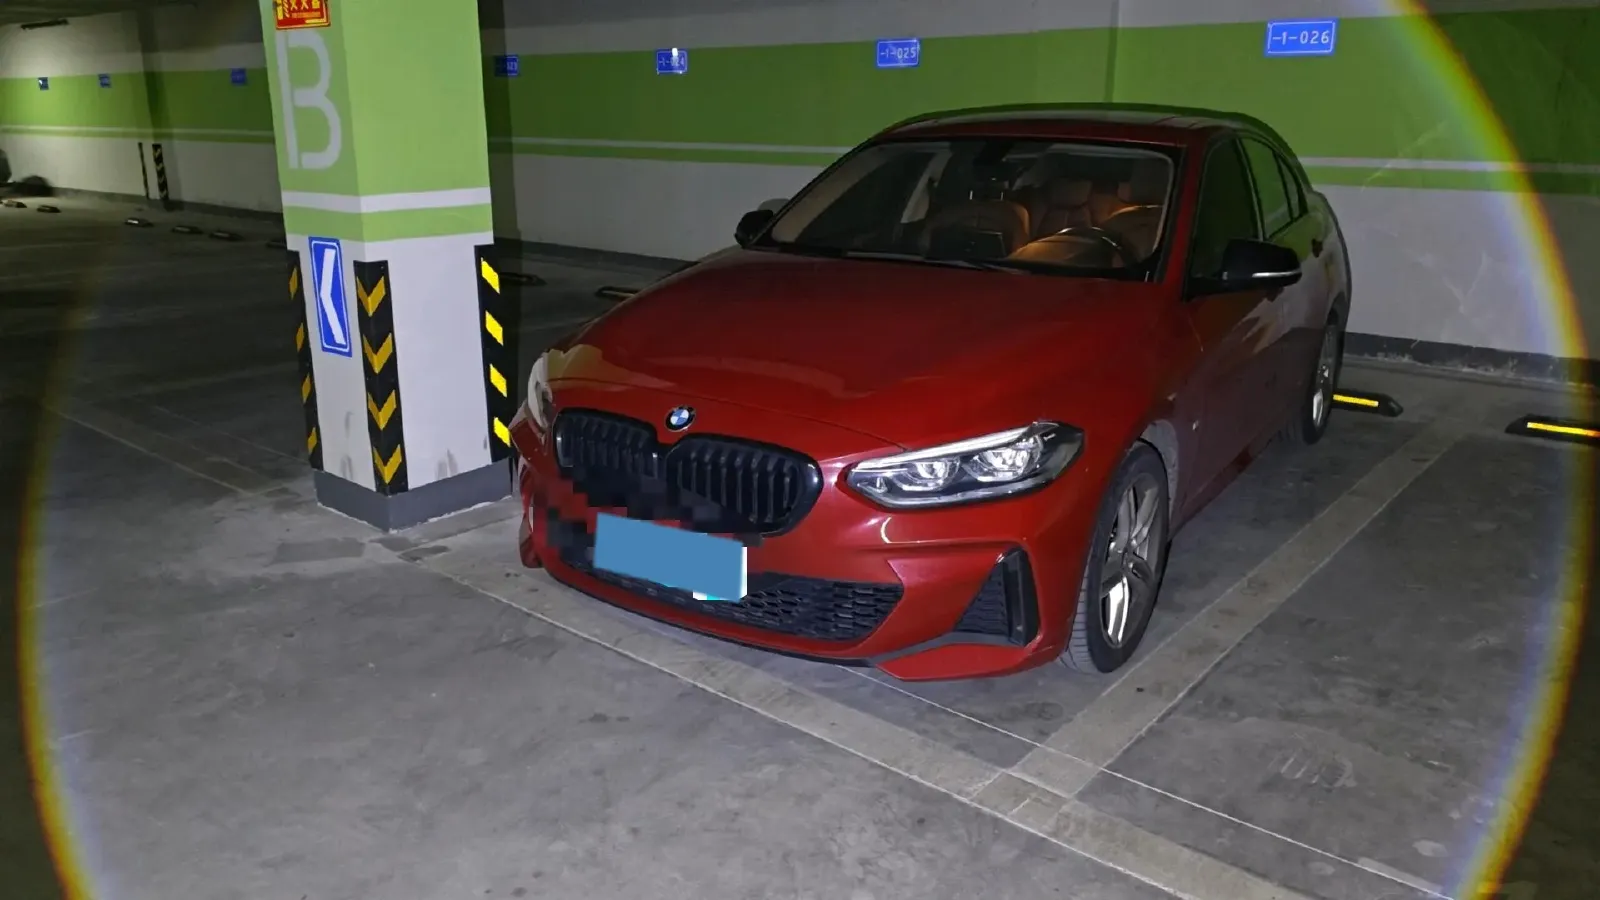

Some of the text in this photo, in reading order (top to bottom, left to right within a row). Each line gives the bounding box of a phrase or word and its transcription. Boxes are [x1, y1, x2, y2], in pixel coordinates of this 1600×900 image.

[1272, 30, 1330, 45] -1-026
[880, 47, 917, 59] -1-025
[275, 30, 342, 169] B
